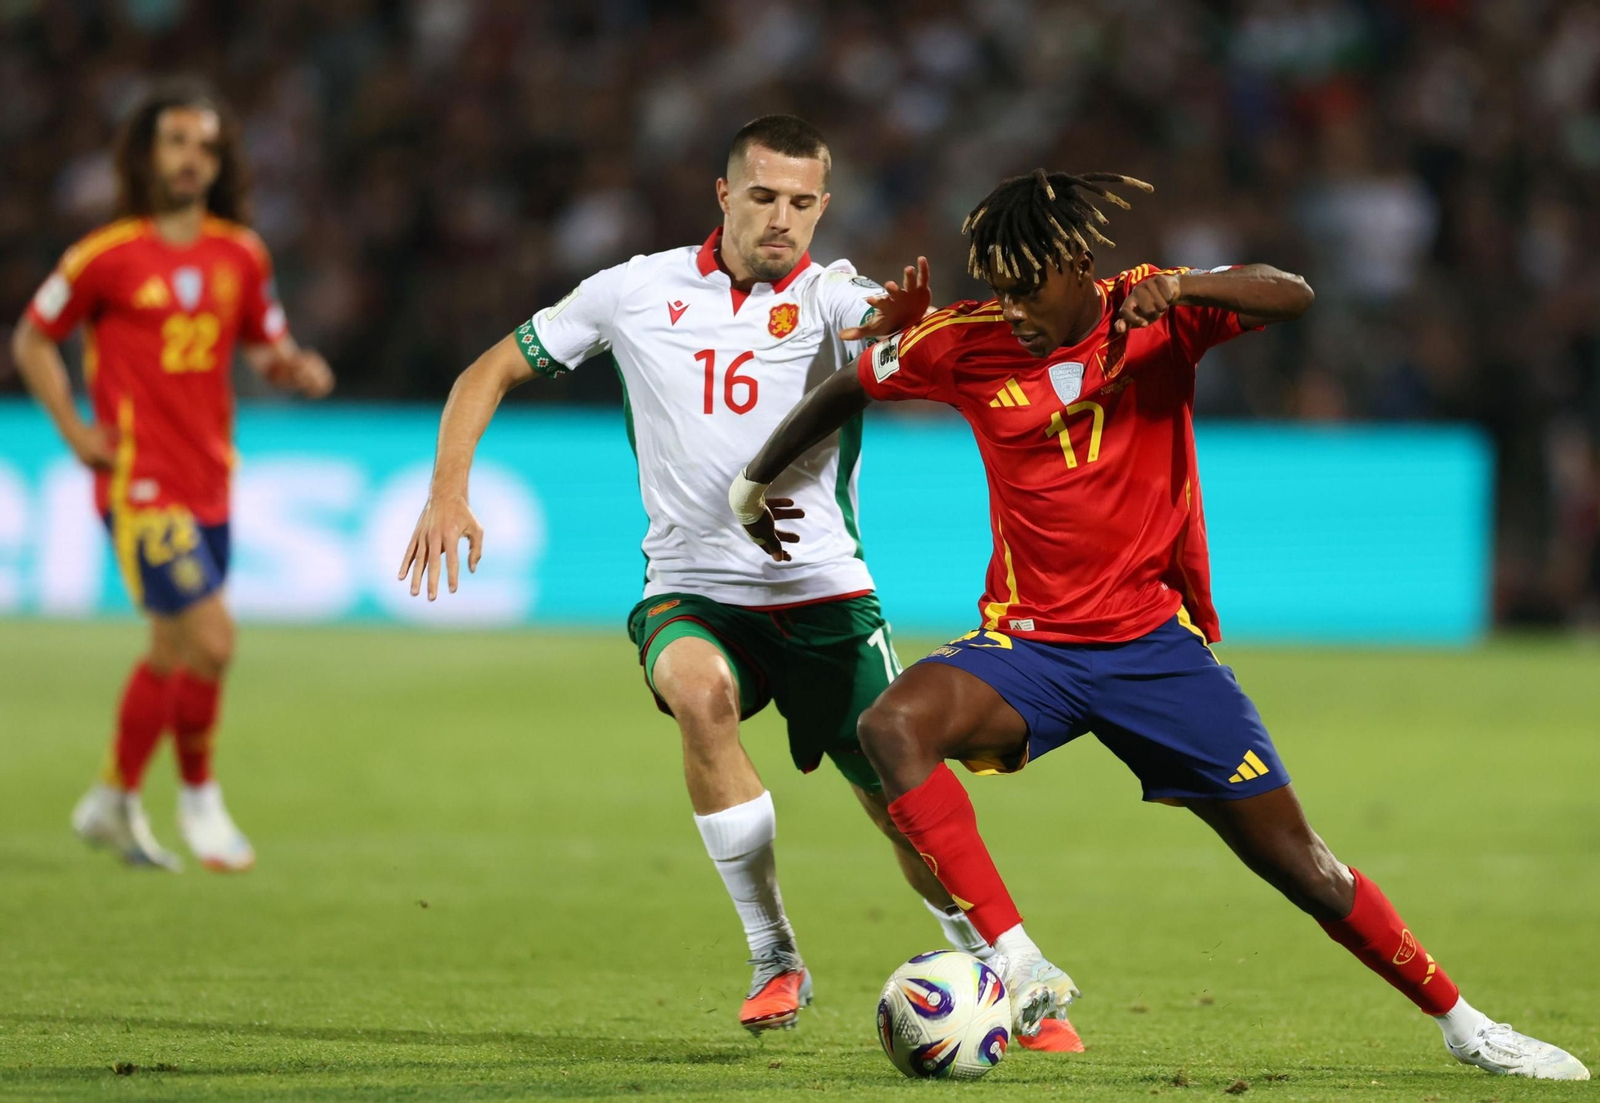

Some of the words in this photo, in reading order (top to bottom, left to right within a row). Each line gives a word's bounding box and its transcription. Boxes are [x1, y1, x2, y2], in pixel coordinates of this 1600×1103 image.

[161, 312, 219, 373] 22
[694, 349, 758, 415] 16
[1044, 401, 1105, 469] 17
